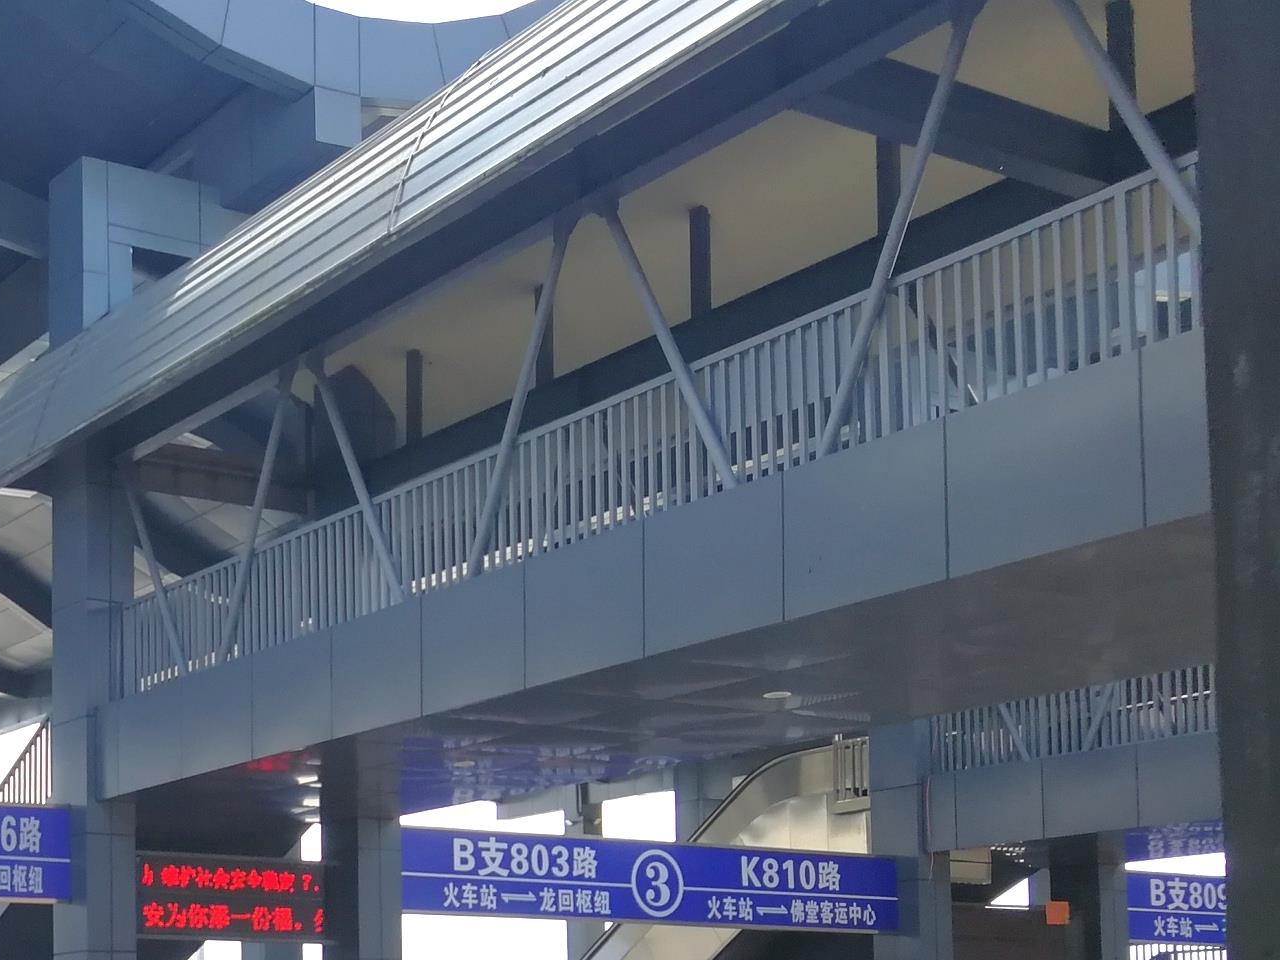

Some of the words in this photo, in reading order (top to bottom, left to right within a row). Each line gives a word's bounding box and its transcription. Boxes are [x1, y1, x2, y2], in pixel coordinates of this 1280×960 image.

[453, 836, 598, 880] B支803路
[741, 855, 842, 892] K810路
[443, 883, 498, 911] 火车站
[538, 888, 612, 916] 龙回枢纽
[707, 896, 754, 922] 火车站
[790, 898, 878, 927] 佛堂客运中心
[1153, 915, 1193, 939] 火车站
